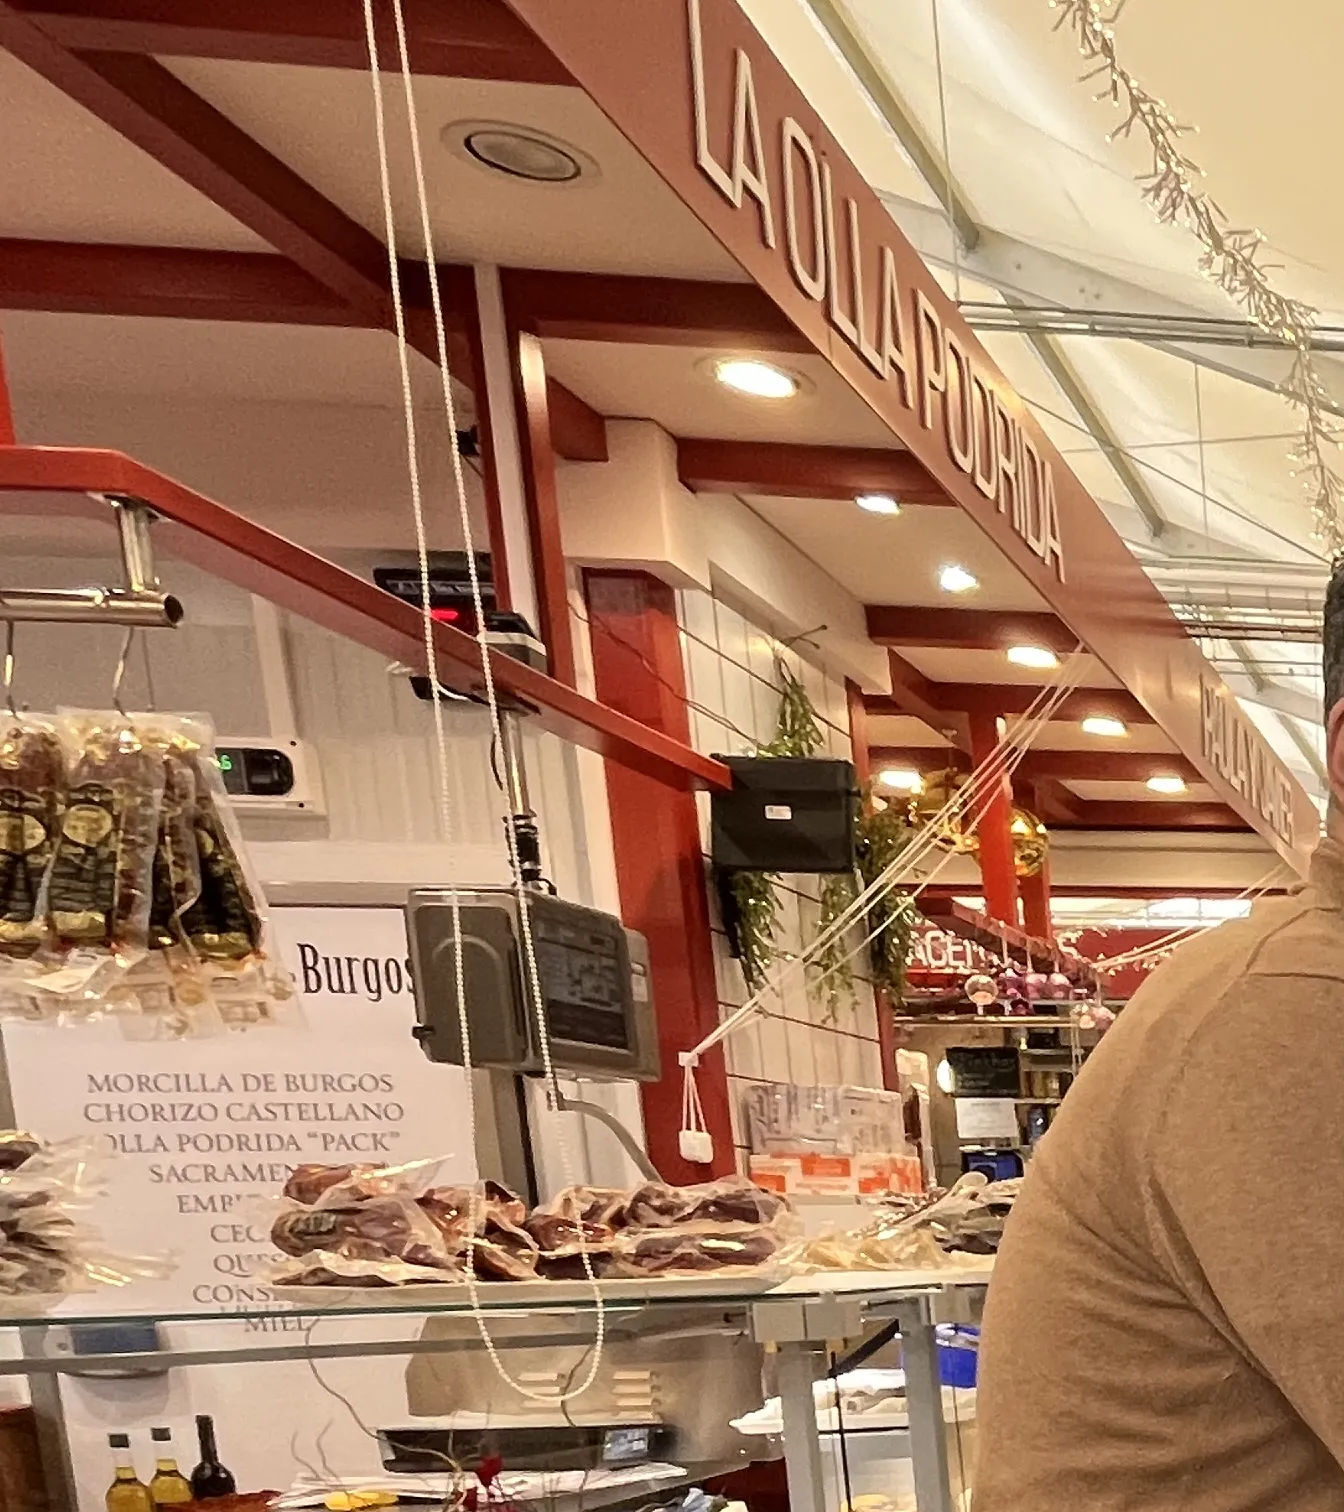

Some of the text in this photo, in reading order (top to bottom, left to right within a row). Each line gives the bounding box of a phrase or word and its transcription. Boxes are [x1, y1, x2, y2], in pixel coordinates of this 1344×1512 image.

[686, 0, 1066, 584] LA OLLA PODRIDA
[87, 1073, 395, 1094] MORCILLA DE BURGOS
[84, 1102, 405, 1124] CHORIZO CASTELLANO
[177, 1132, 302, 1153] PODRIDA
